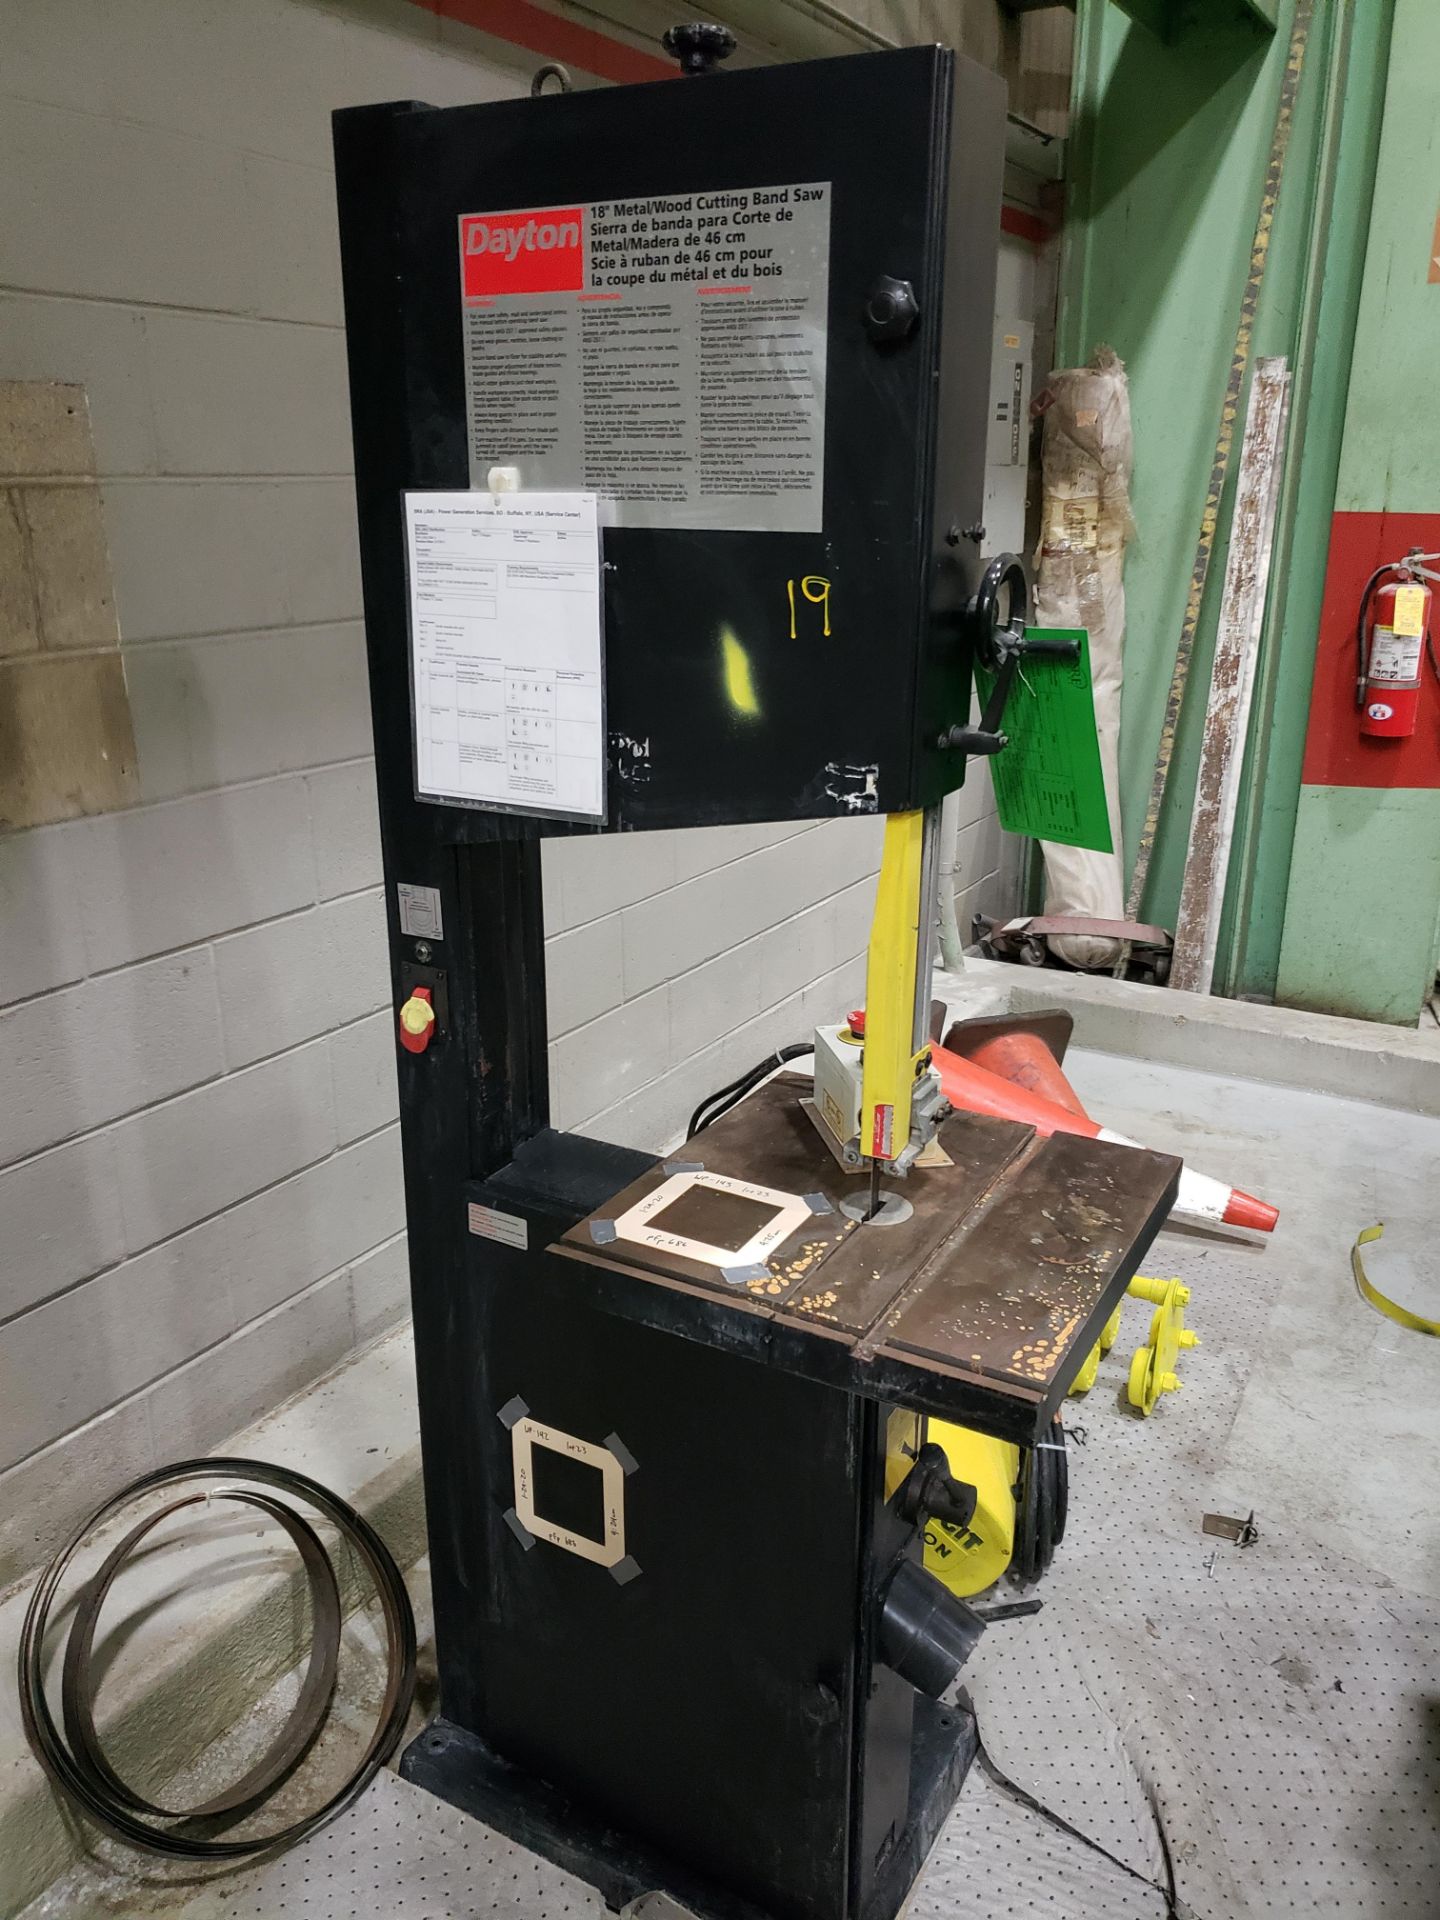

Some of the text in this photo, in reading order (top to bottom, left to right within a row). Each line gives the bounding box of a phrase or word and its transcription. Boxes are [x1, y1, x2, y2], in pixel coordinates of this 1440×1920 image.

[590, 188, 823, 219] 18" Metal/Wood Cutting Band Saw
[591, 208, 793, 236] Sierra de banda para Corte de
[466, 219, 579, 262] Dayton
[591, 231, 746, 253] Metal/Madera de 46 cm
[591, 248, 773, 270] Scie à ruban de 46 cm pour
[591, 263, 782, 288] la coupe du métal et du bois
[787, 575, 831, 639] 19
